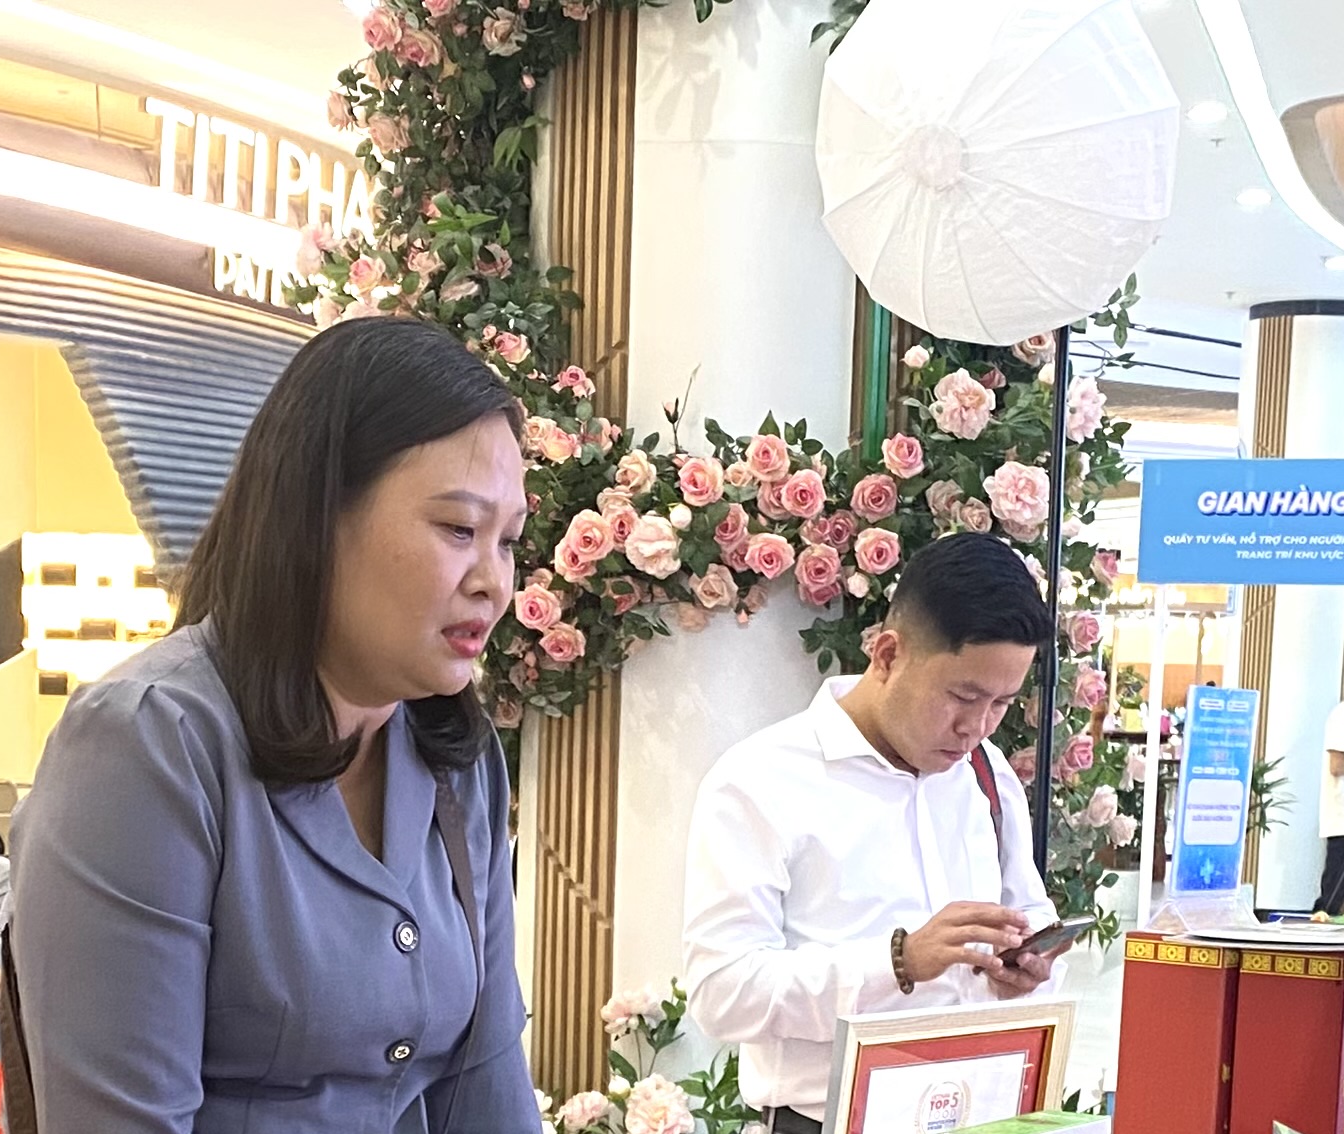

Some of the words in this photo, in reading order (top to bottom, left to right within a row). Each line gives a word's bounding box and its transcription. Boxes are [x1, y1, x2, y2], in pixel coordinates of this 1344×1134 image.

[1197, 490, 1270, 516] GIAN
[1283, 536, 1306, 545] CHO
[1236, 551, 1272, 559] TRANG
[1294, 551, 1318, 559] KHU
[929, 1100, 950, 1112] TOP
[950, 1091, 959, 1109] 5
